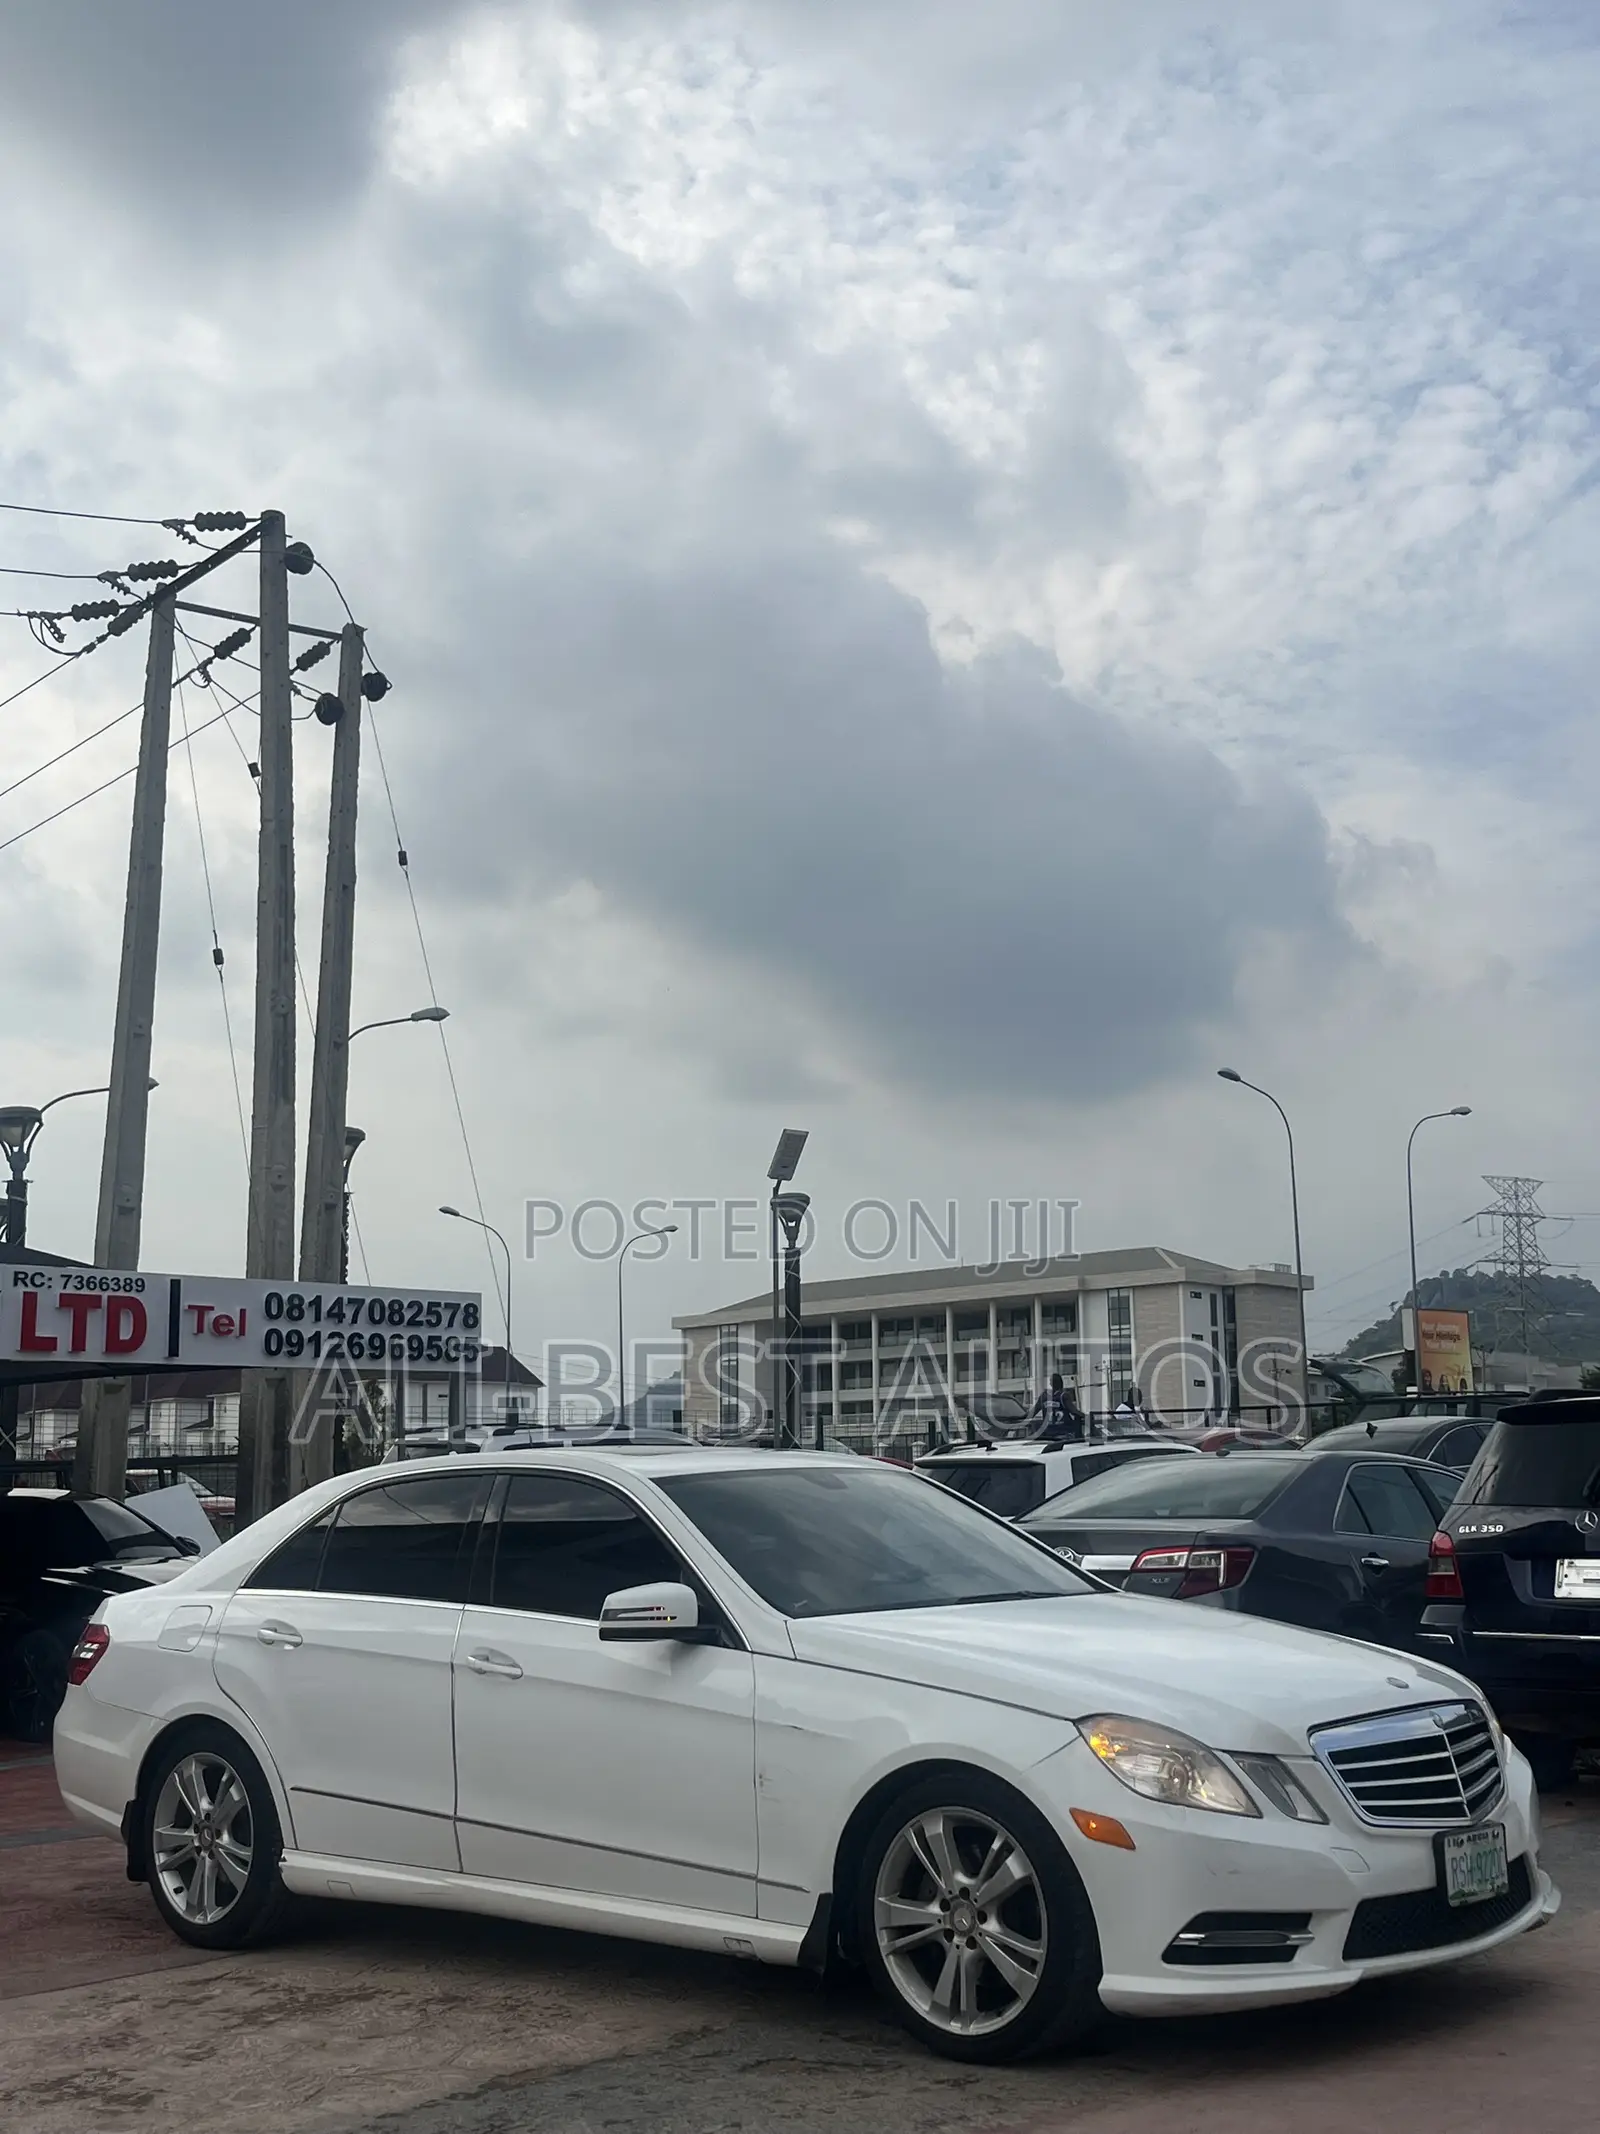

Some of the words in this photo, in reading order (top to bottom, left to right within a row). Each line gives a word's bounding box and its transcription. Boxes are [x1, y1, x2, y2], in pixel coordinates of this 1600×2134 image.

[13, 1271, 53, 1289] RC:
[60, 1274, 146, 1293] 7366389
[20, 1291, 147, 1354] LTD
[185, 1304, 247, 1337] Tel
[264, 1292, 479, 1329] 08147082578
[1458, 1525, 1478, 1534] GLK
[1480, 1524, 1504, 1533] 350
